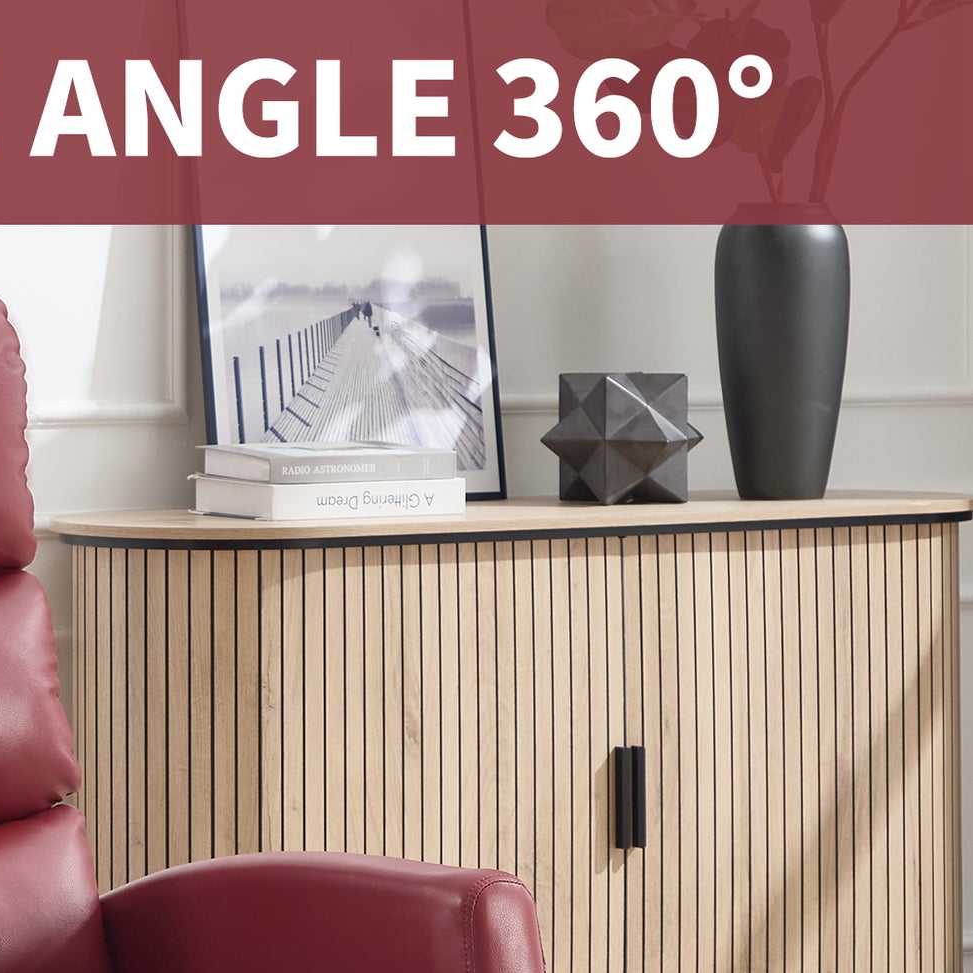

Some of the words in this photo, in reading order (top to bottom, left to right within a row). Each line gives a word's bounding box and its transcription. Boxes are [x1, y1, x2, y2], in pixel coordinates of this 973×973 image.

[281, 464, 311, 475] RADIO
[313, 463, 377, 474] ASTRONOMER
[317, 495, 358, 509] Dream
[363, 490, 420, 509] Glittering
[424, 493, 434, 507] A
